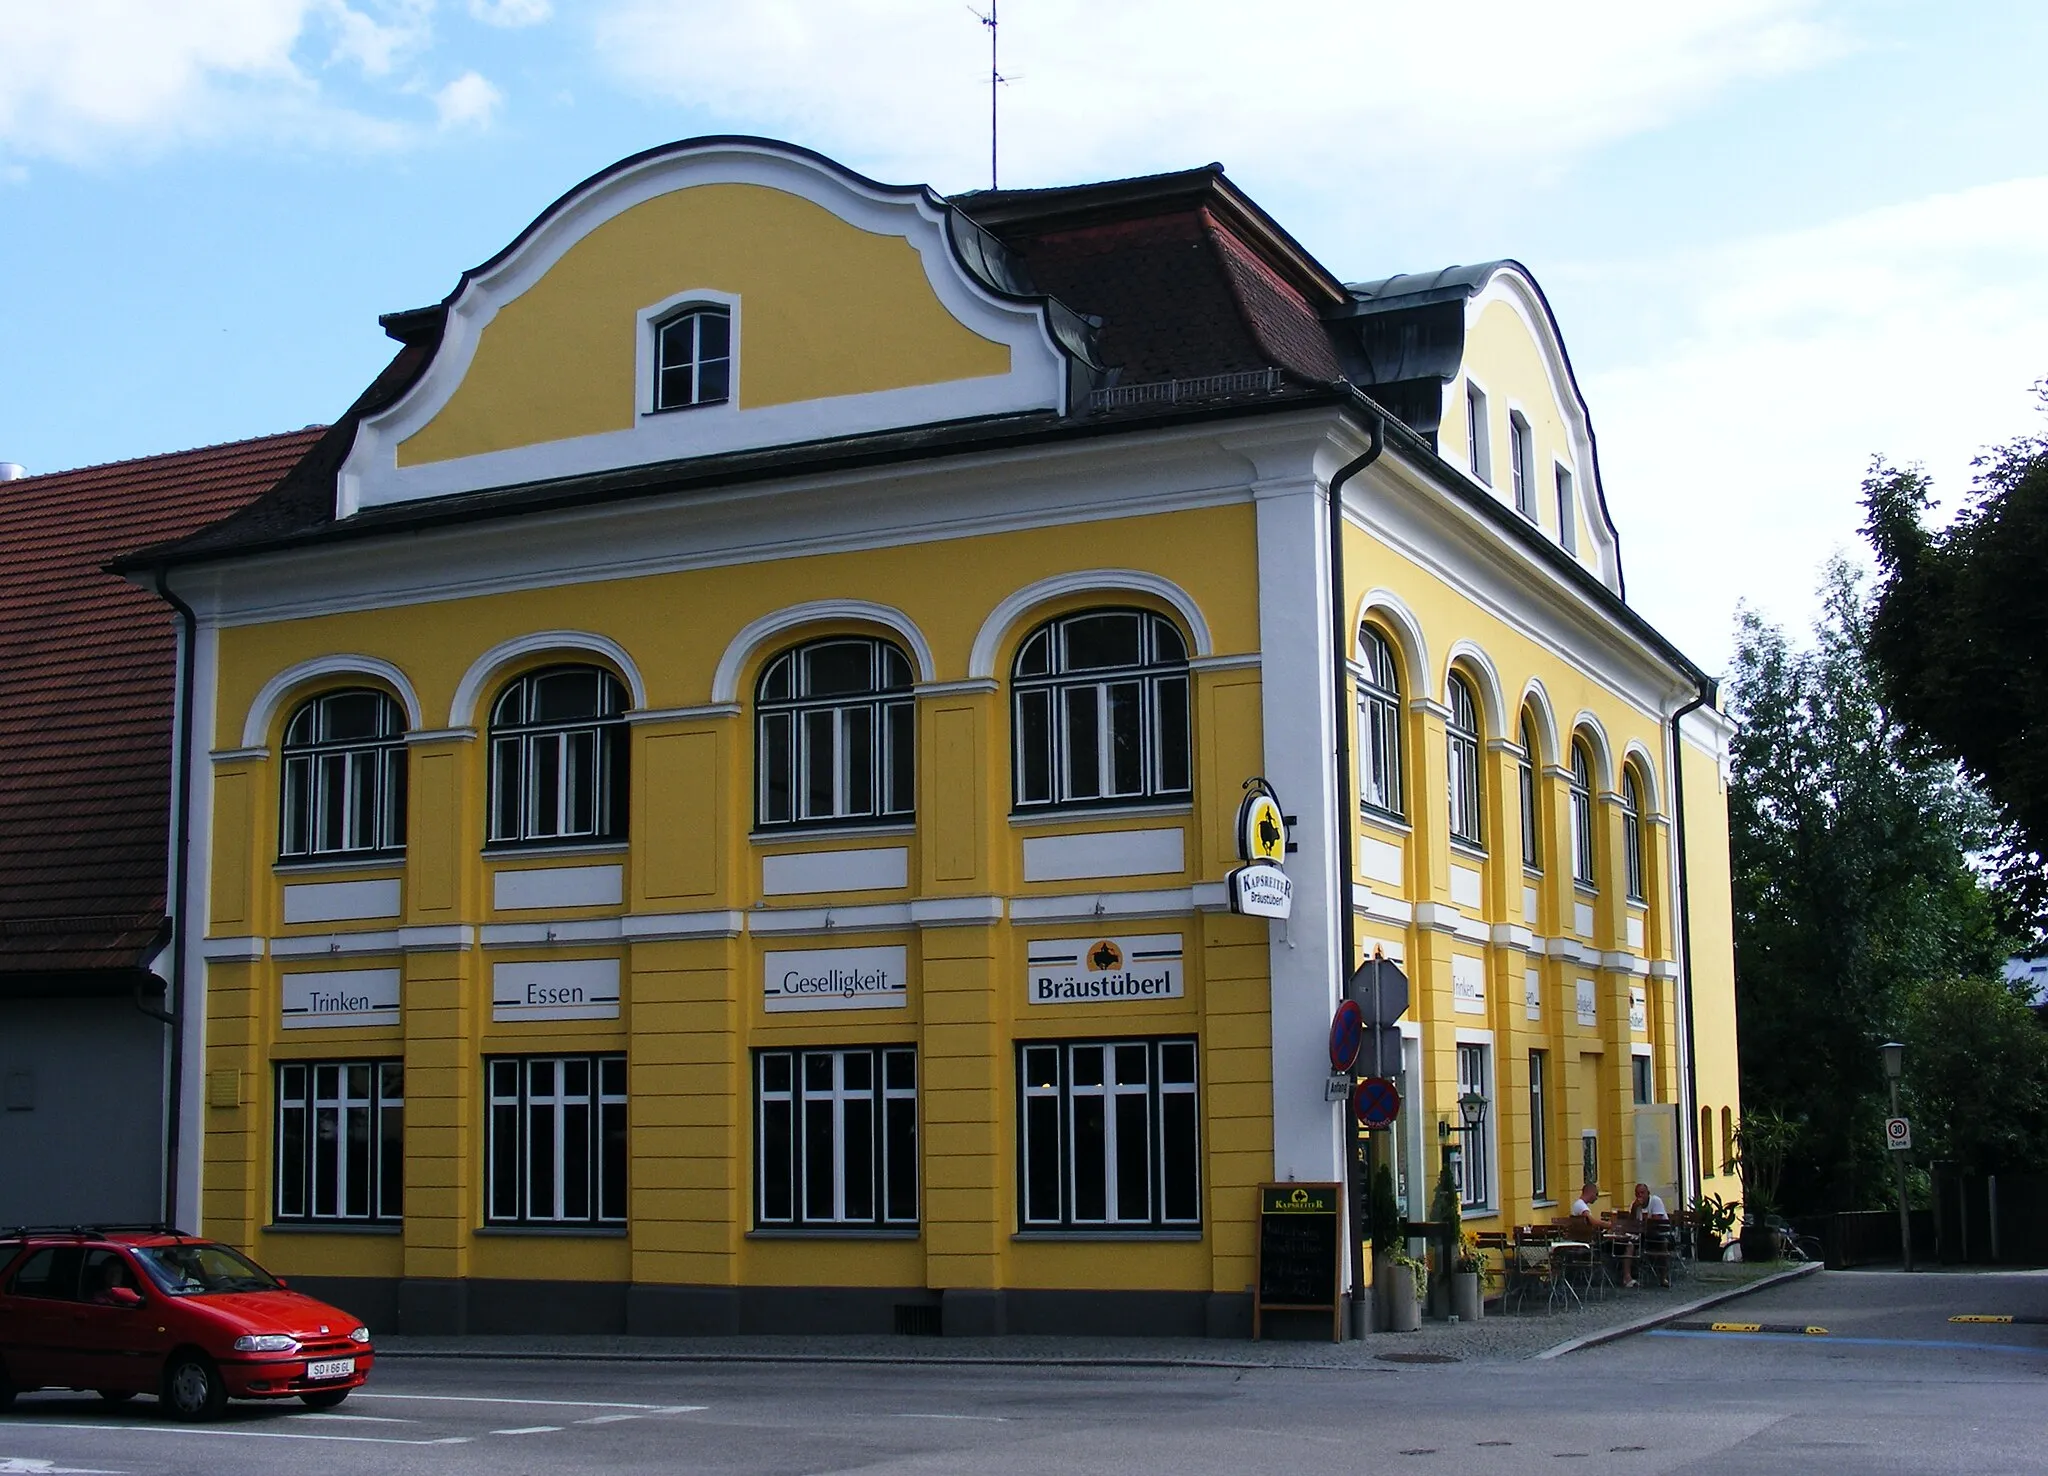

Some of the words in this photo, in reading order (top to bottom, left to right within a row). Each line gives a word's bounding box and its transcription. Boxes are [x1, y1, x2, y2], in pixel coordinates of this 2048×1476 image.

[1243, 874, 1291, 899] KAPSREITER
[783, 969, 888, 998] Geselligkeit
[1038, 971, 1171, 999] Bräustüberl
[309, 992, 369, 1012] Trinken
[527, 984, 583, 1005] Essen
[1893, 1124, 1903, 1135] 30
[314, 1365, 325, 1375] SD
